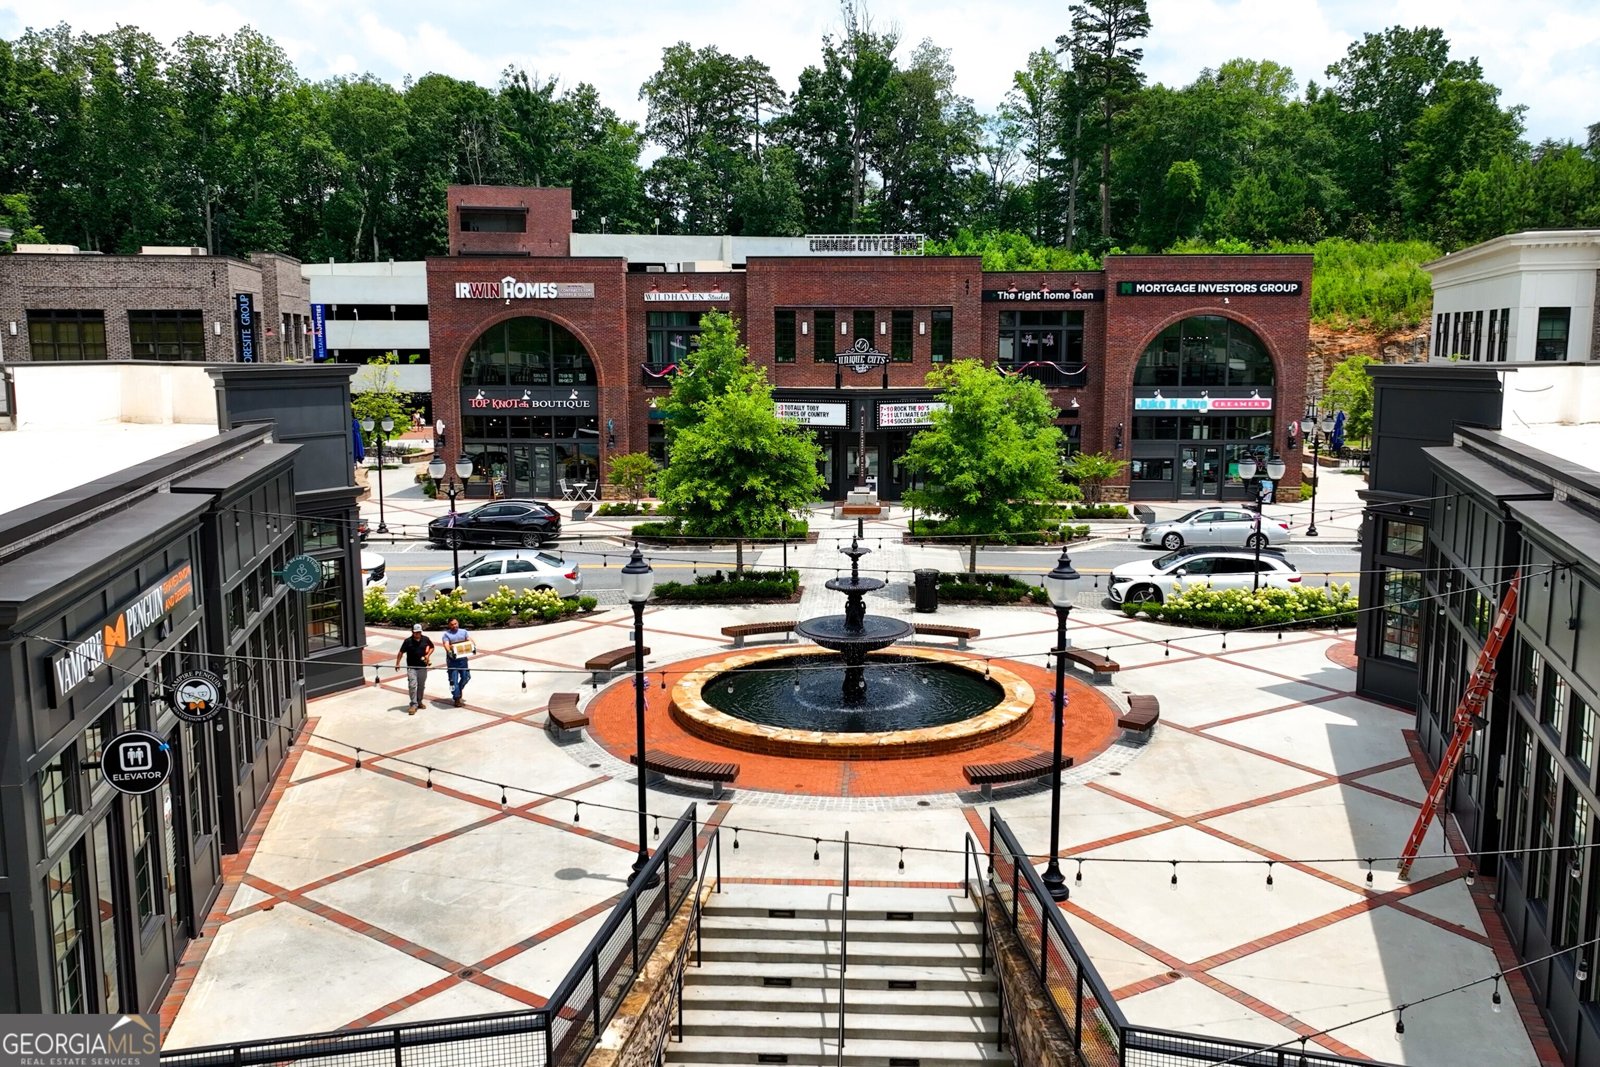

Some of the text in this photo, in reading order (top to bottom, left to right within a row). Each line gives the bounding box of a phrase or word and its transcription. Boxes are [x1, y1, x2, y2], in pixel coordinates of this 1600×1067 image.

[809, 239, 856, 252] CUMMING
[857, 239, 880, 252] CITY
[455, 282, 500, 299] IRWIN
[502, 280, 558, 299] HOMES
[1136, 283, 1298, 293] MORTGAGE INVESTORS GROUP
[645, 293, 705, 301] WILDHAVEN
[997, 290, 1094, 302] The right home loan
[240, 294, 253, 363] ORESITE GROUP
[838, 355, 886, 365] UNIQUE CUTS
[468, 399, 491, 408] TOP
[532, 400, 591, 409] BOUTIQUE
[1214, 400, 1267, 408] CREAMERY
[55, 584, 165, 697] VAMPIRE PENGUIN
[169, 670, 223, 692] VAMPIRE PENGUIN
[112, 771, 162, 782] ELEVATOR
